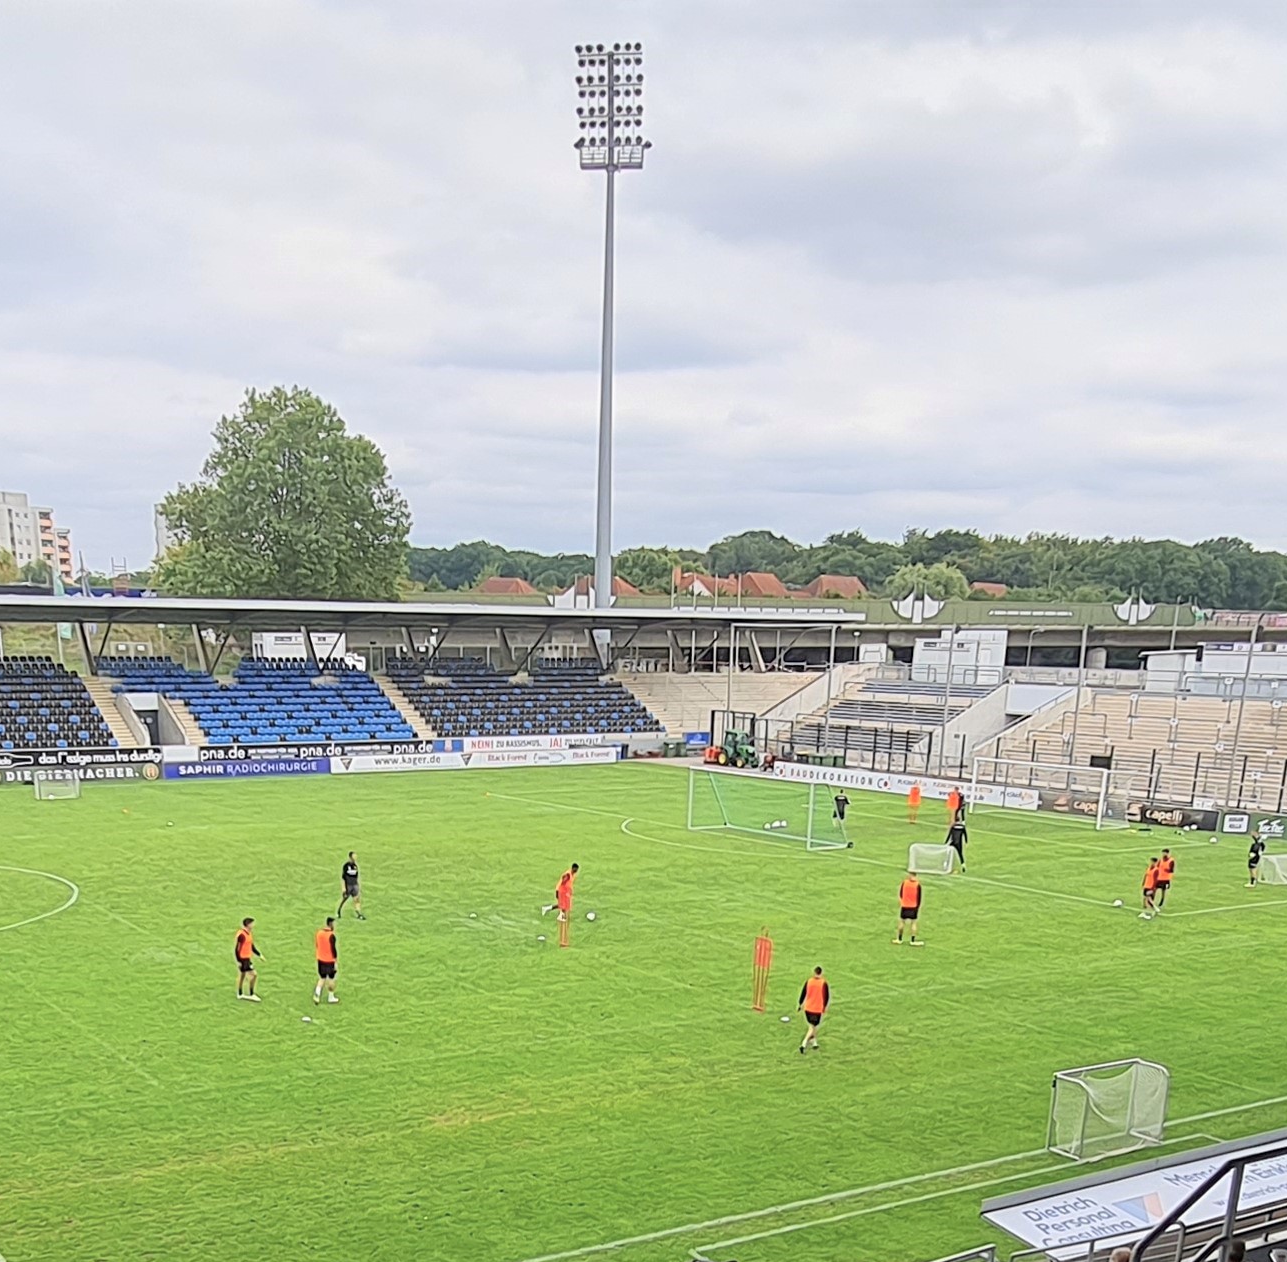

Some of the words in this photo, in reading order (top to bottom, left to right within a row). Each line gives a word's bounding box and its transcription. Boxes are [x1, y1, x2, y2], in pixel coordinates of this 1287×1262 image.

[200, 745, 246, 761] pna.de
[299, 743, 342, 758] pna.de
[393, 740, 433, 755] pna.de
[178, 765, 225, 775] SAPHIR
[226, 761, 318, 775] RADIOCHIRURGIE
[6, 771, 32, 782] DIE
[1145, 808, 1183, 824] capelli
[1022, 1196, 1099, 1223] Dietrich
[1035, 1207, 1118, 1236] Personal
